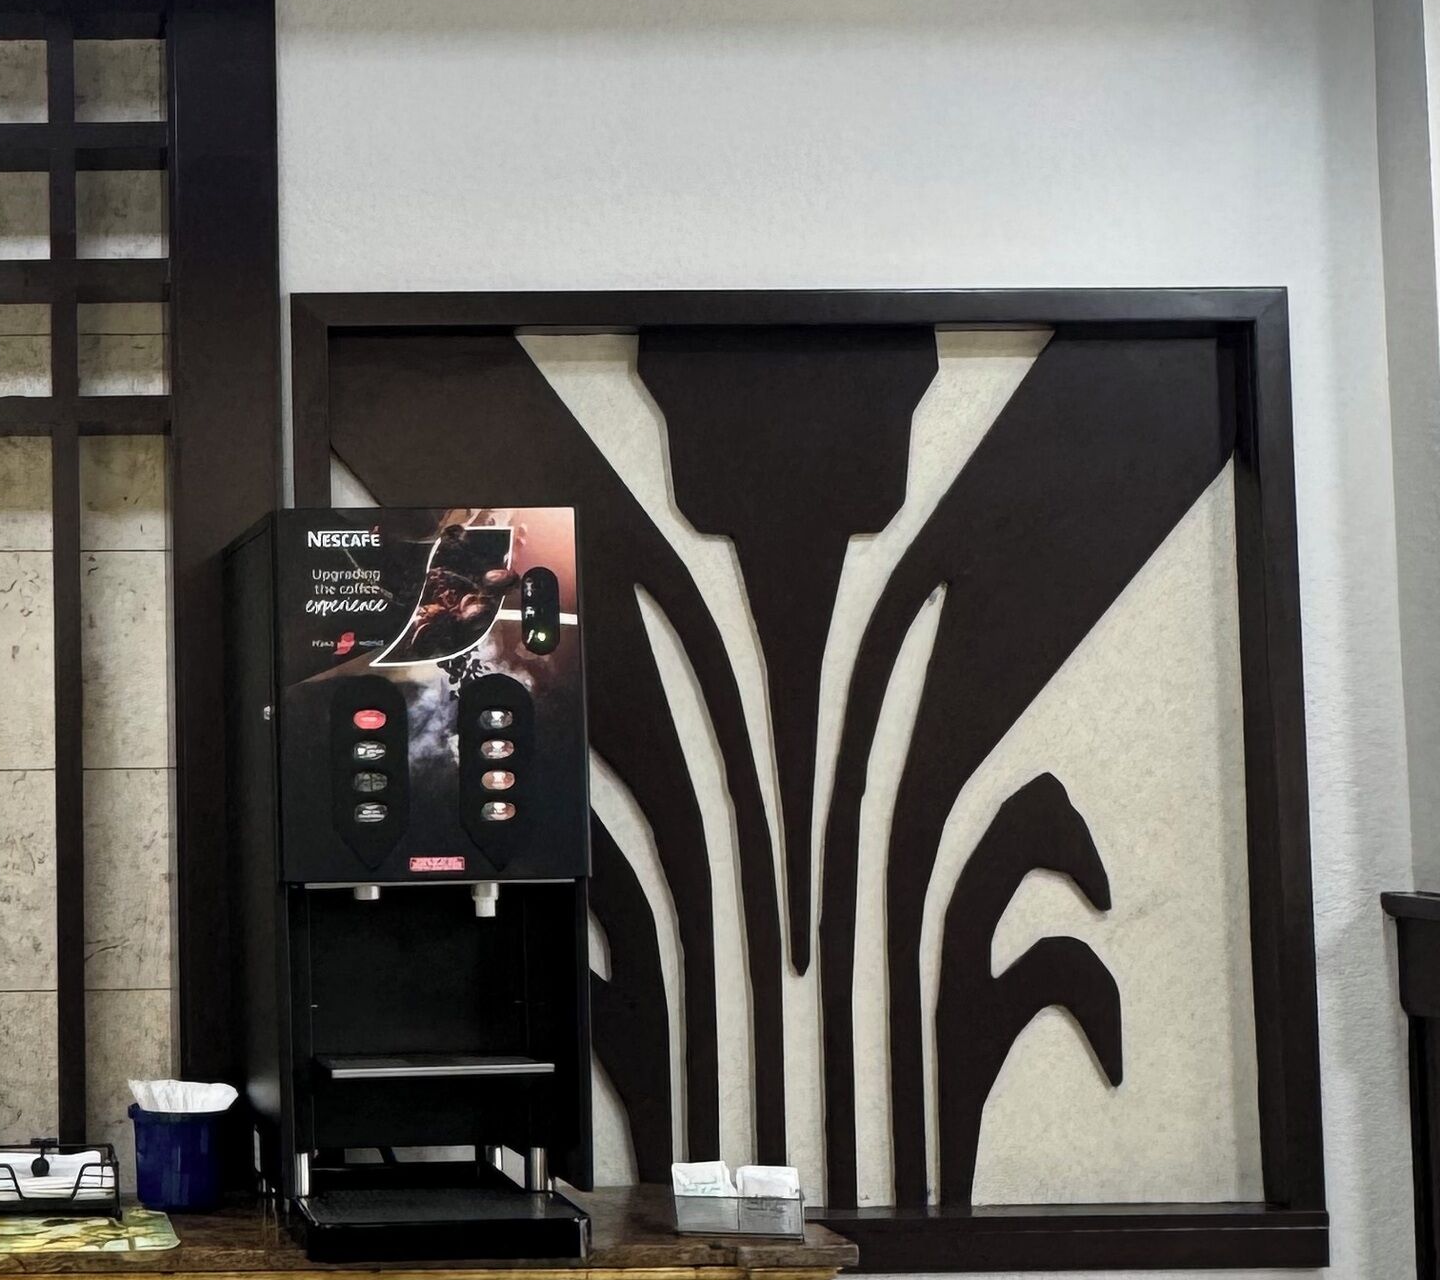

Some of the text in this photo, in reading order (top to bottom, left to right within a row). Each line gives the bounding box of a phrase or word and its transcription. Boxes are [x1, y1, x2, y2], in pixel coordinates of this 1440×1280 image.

[312, 569, 381, 582] Upgrading
[315, 583, 381, 595] the coffee
[305, 597, 389, 616] experience
